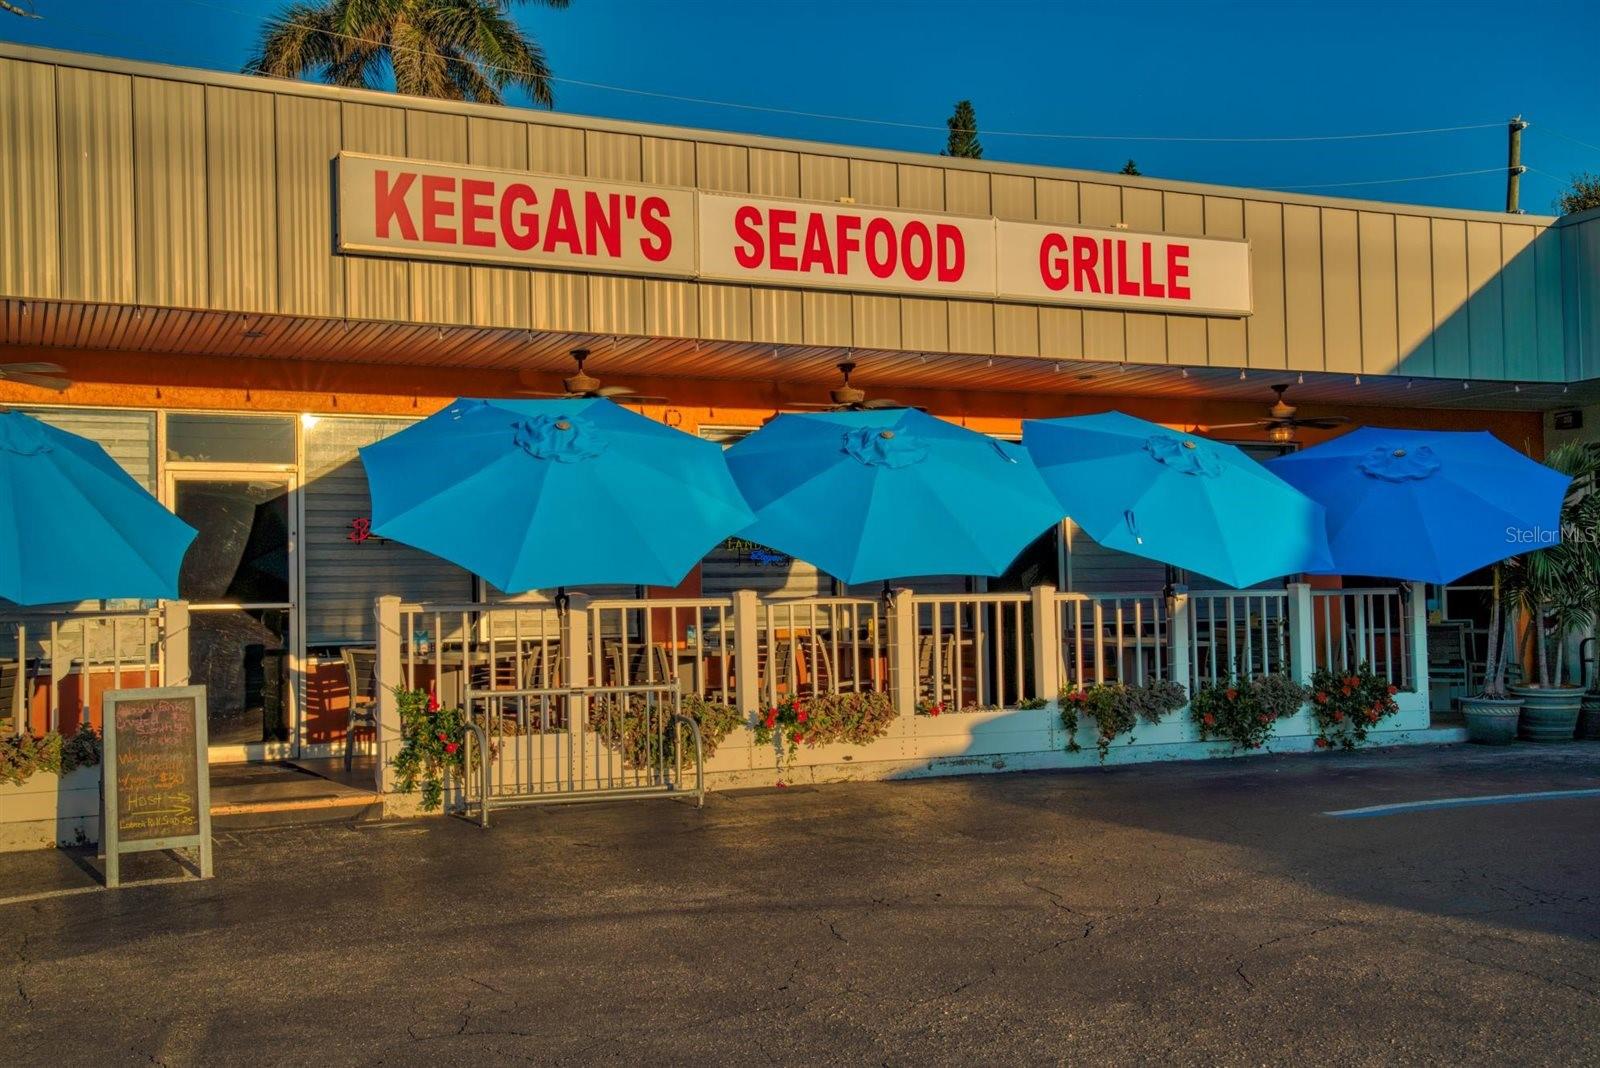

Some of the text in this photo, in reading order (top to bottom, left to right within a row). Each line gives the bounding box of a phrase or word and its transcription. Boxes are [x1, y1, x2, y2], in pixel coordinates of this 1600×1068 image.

[376, 171, 1191, 300] KEEGAN'S SEAFOOD GRILLE
